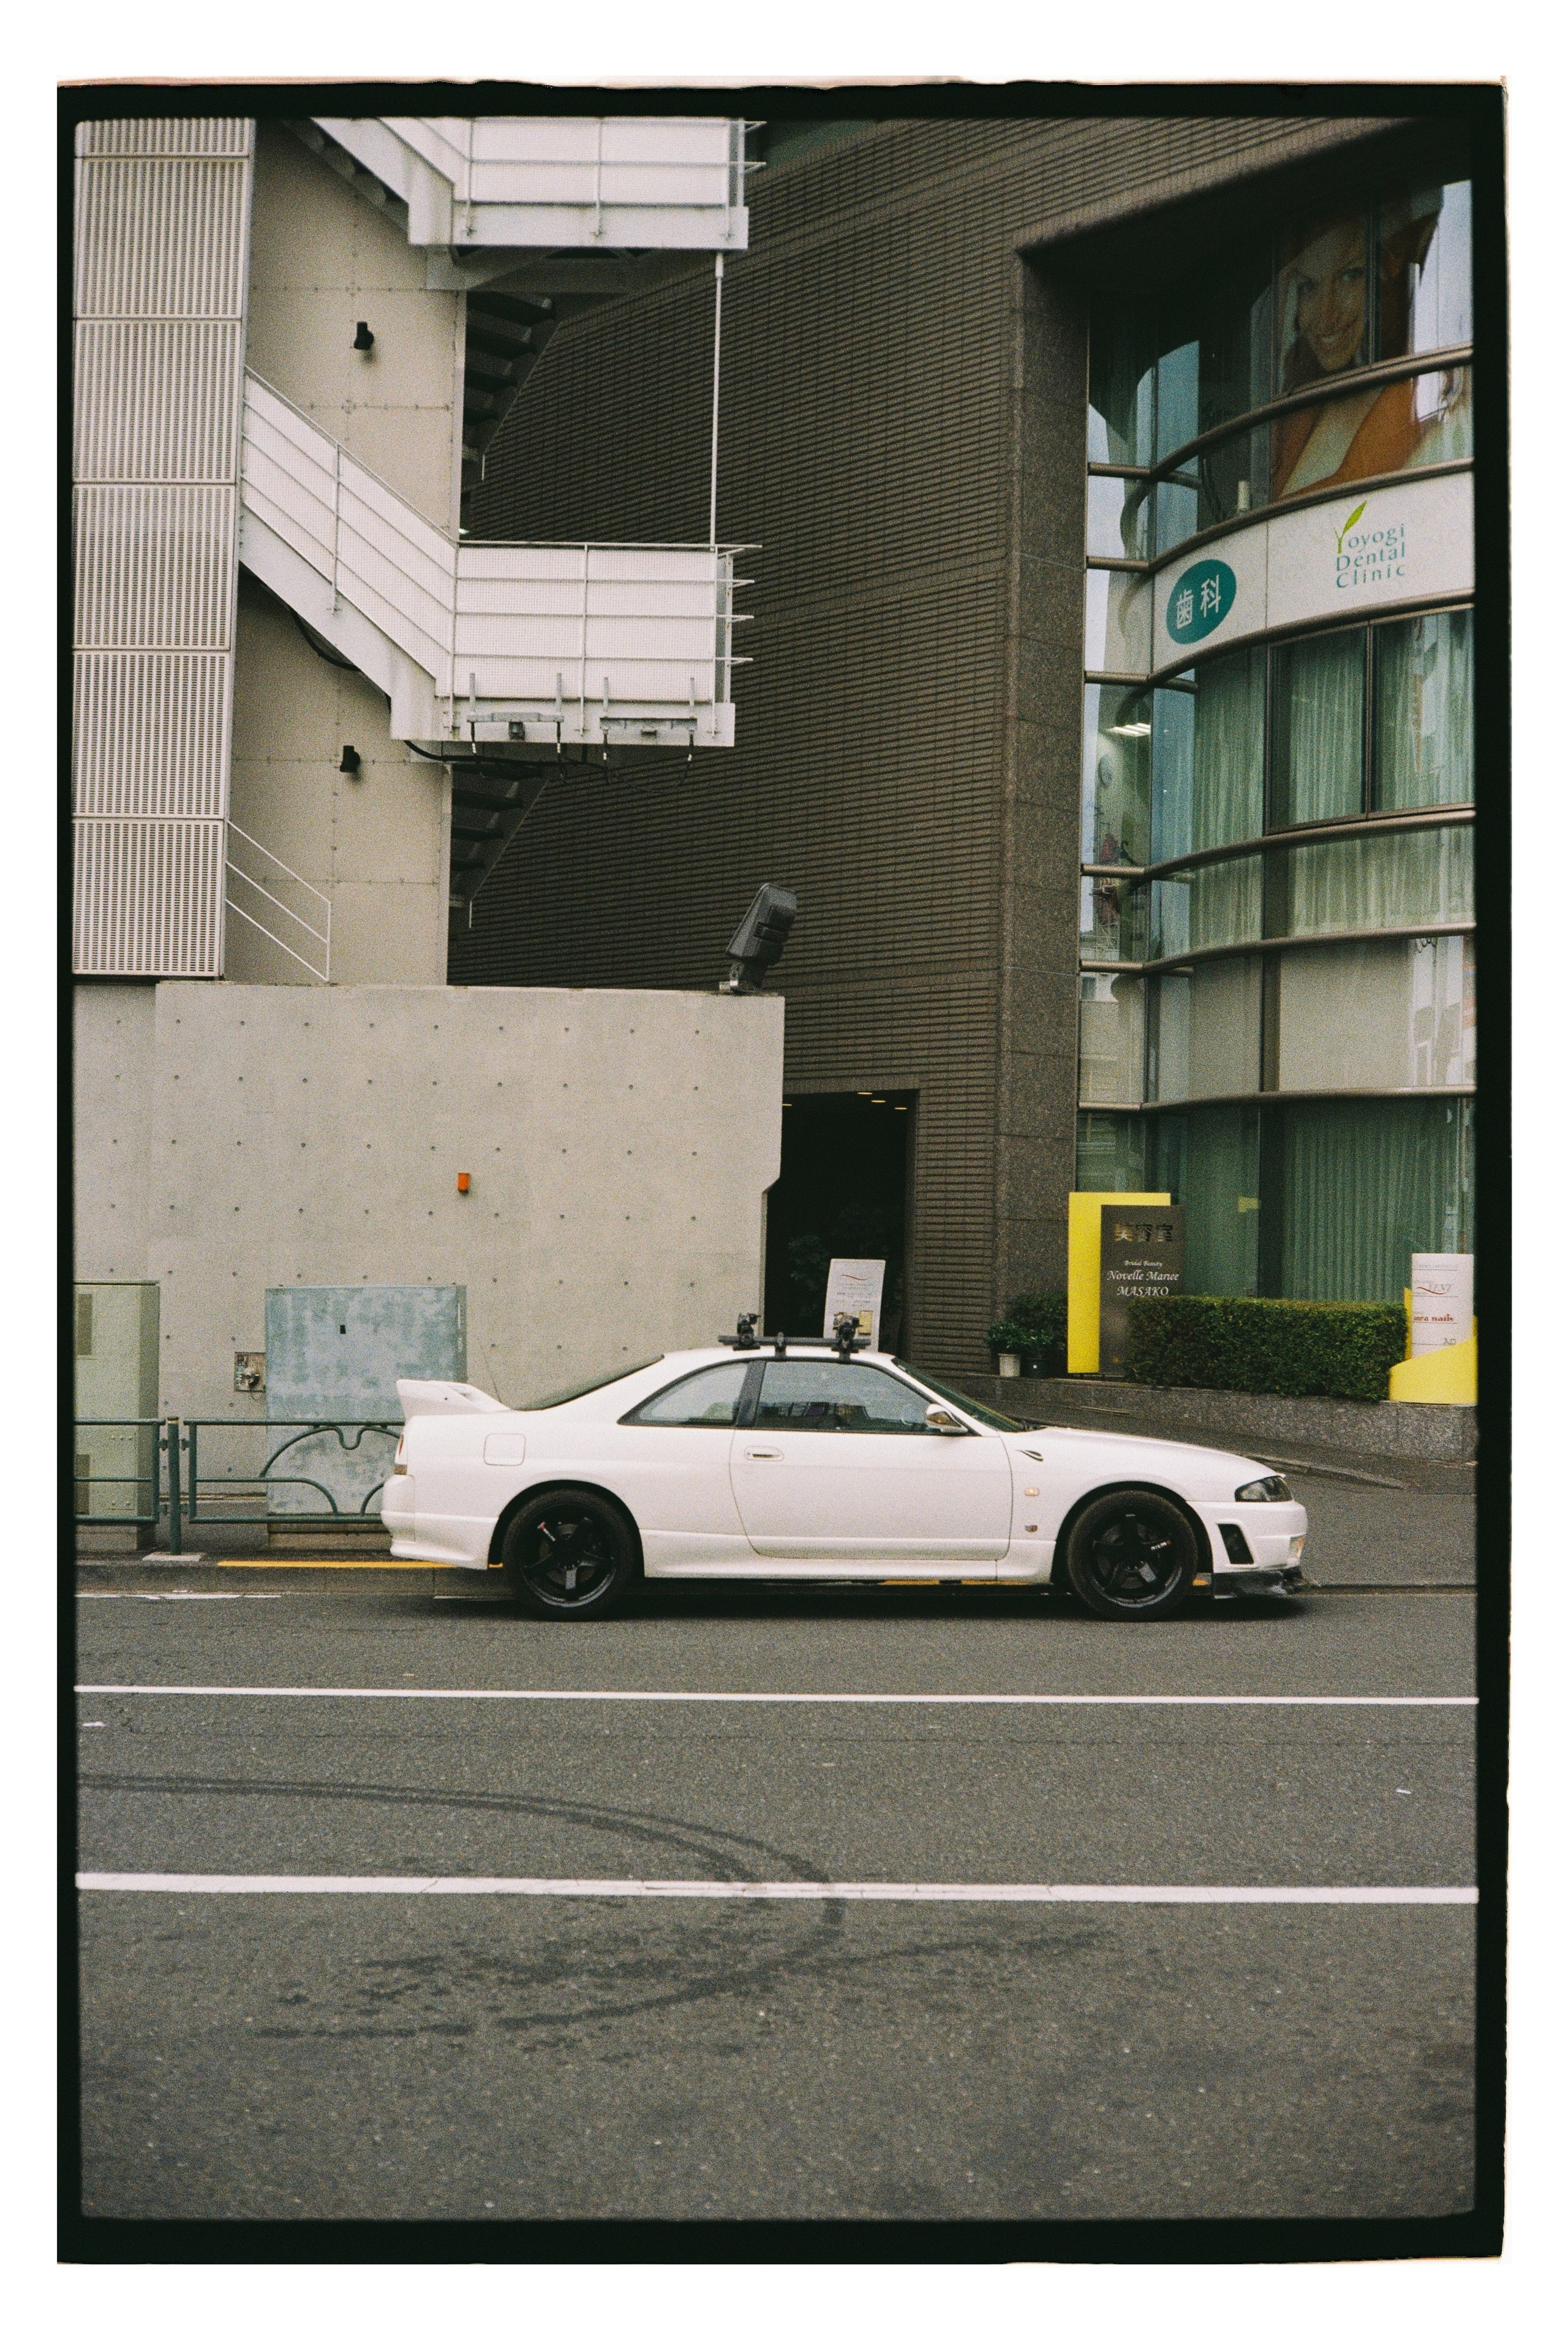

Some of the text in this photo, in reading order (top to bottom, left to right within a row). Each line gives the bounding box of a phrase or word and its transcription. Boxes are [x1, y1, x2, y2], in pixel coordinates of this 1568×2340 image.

[1336, 543, 1405, 572] Dental
[1336, 564, 1406, 589] Clinic
[1176, 573, 1221, 630] 歯科
[1114, 1223, 1174, 1242] 美容室
[1106, 1269, 1144, 1281] Novelle
[1116, 1286, 1169, 1297] MASAKO
